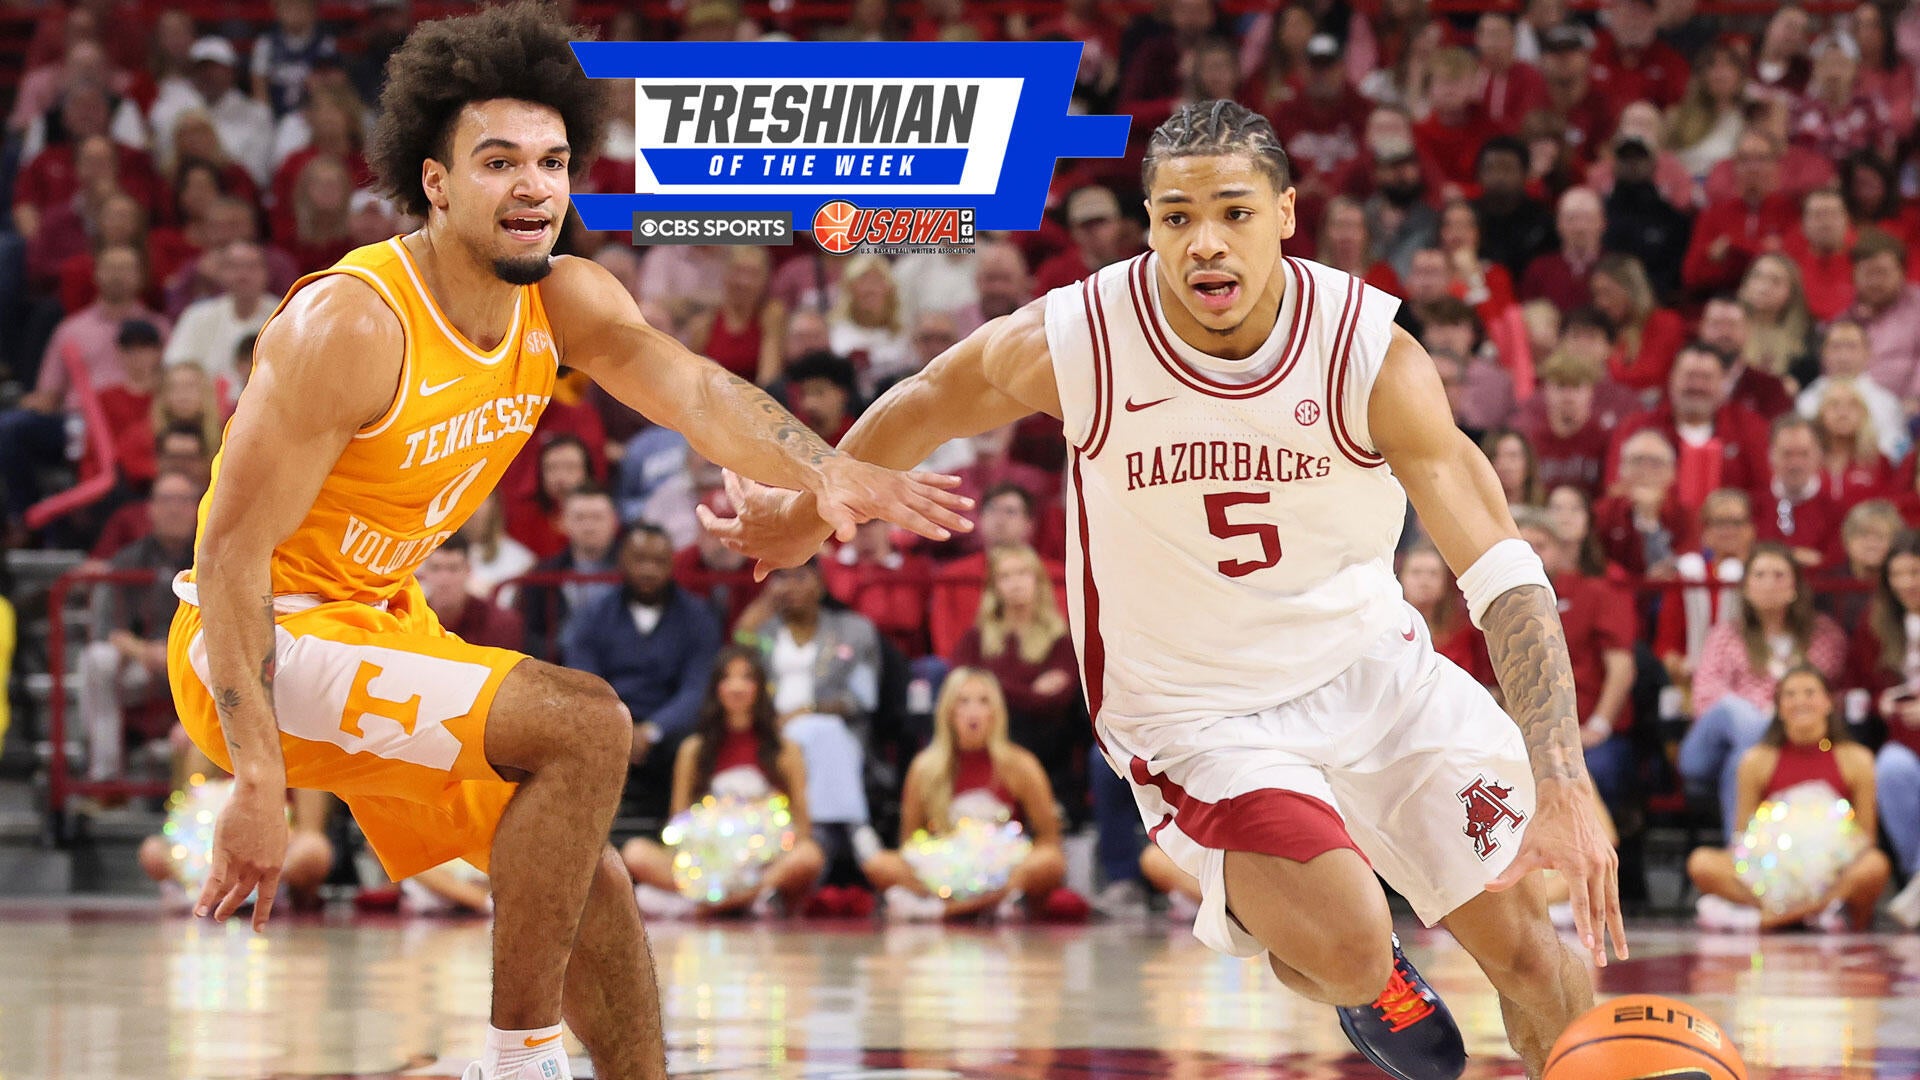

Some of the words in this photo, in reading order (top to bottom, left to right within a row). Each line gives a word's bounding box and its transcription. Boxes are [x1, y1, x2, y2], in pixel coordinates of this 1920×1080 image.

[526, 330, 549, 353] SEC
[1295, 400, 1320, 426] SEC
[1126, 441, 1332, 491] RAZORBACKS
[424, 457, 488, 529] 0
[1203, 491, 1282, 578] 5
